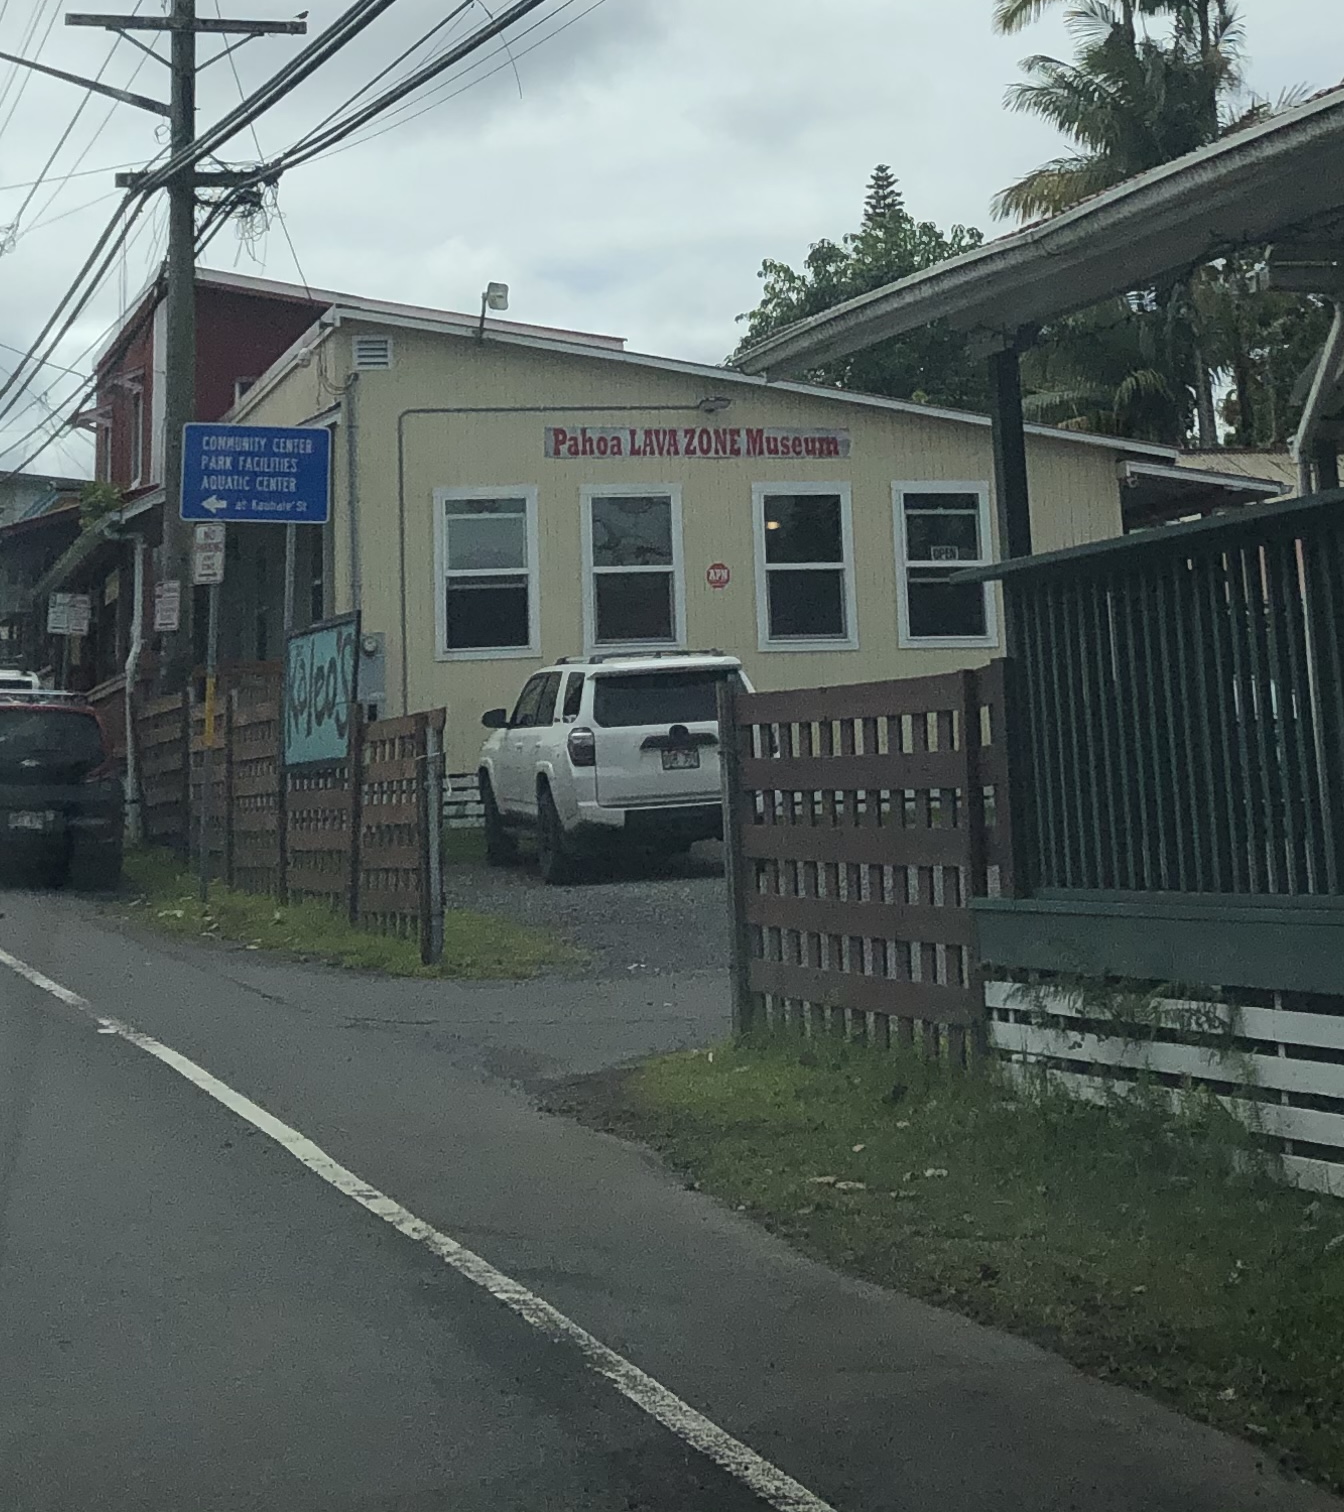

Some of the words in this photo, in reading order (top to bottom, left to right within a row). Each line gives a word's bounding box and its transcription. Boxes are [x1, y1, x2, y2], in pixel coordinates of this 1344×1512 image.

[202, 436, 267, 452] COMMUNITY
[272, 438, 313, 454] CENTER
[552, 428, 623, 457] Pahoa
[629, 428, 680, 456] LAVA
[683, 428, 742, 456] ZONE
[746, 428, 840, 456] Museum
[201, 455, 233, 471] PARK
[238, 456, 299, 473] FACILITIES
[200, 475, 250, 491] AQUATIC
[256, 476, 297, 493] CENTER
[235, 500, 247, 510] at
[296, 500, 307, 512] St
